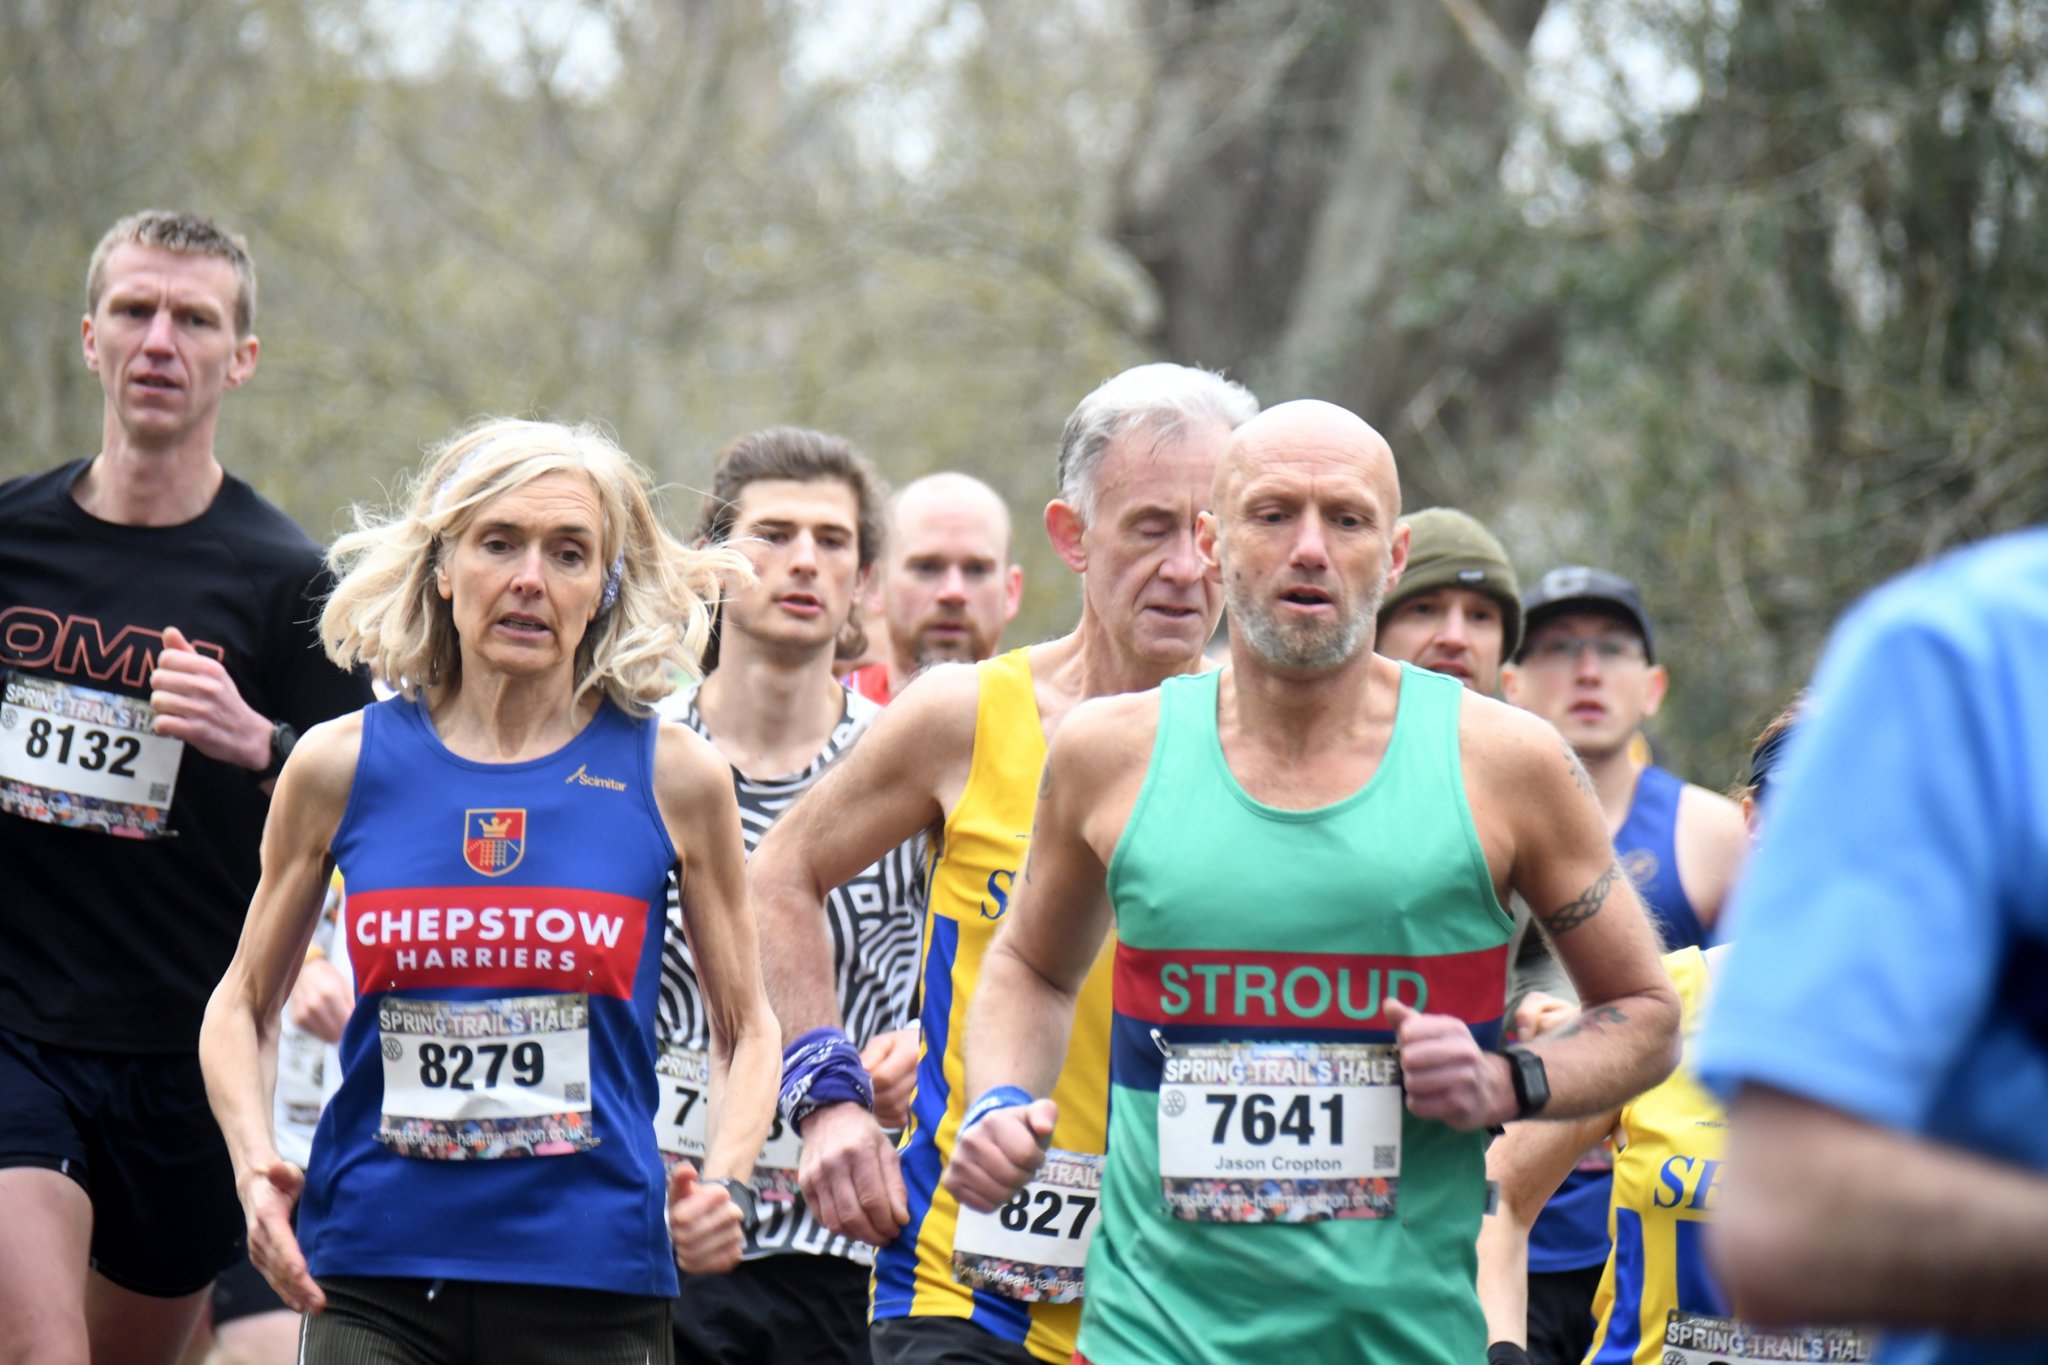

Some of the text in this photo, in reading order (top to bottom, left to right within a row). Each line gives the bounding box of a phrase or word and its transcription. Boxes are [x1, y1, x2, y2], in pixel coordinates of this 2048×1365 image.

[5, 684, 63, 713] SPRING
[69, 700, 131, 727] TRAILS
[26, 718, 141, 778] 8132
[578, 772, 627, 792] Scimitar
[356, 907, 624, 948] CHEPSTOW
[396, 947, 576, 972] HARRIERS
[1160, 963, 1428, 1020] STROUD
[380, 1006, 585, 1037] SPRING TRAILS HALF
[418, 1041, 545, 1091] 8279
[1164, 1058, 1397, 1083] SPRING TRAILS HALF
[1206, 1094, 1344, 1146] 7641
[1047, 1163, 1101, 1188] TRAIL
[1215, 1156, 1343, 1173] Jason Cropton
[1653, 1155, 1728, 1211] SE
[1000, 1187, 1099, 1240] 827
[1666, 1323, 1745, 1354] SPRING
[1749, 1334, 1825, 1360] TRAILS
